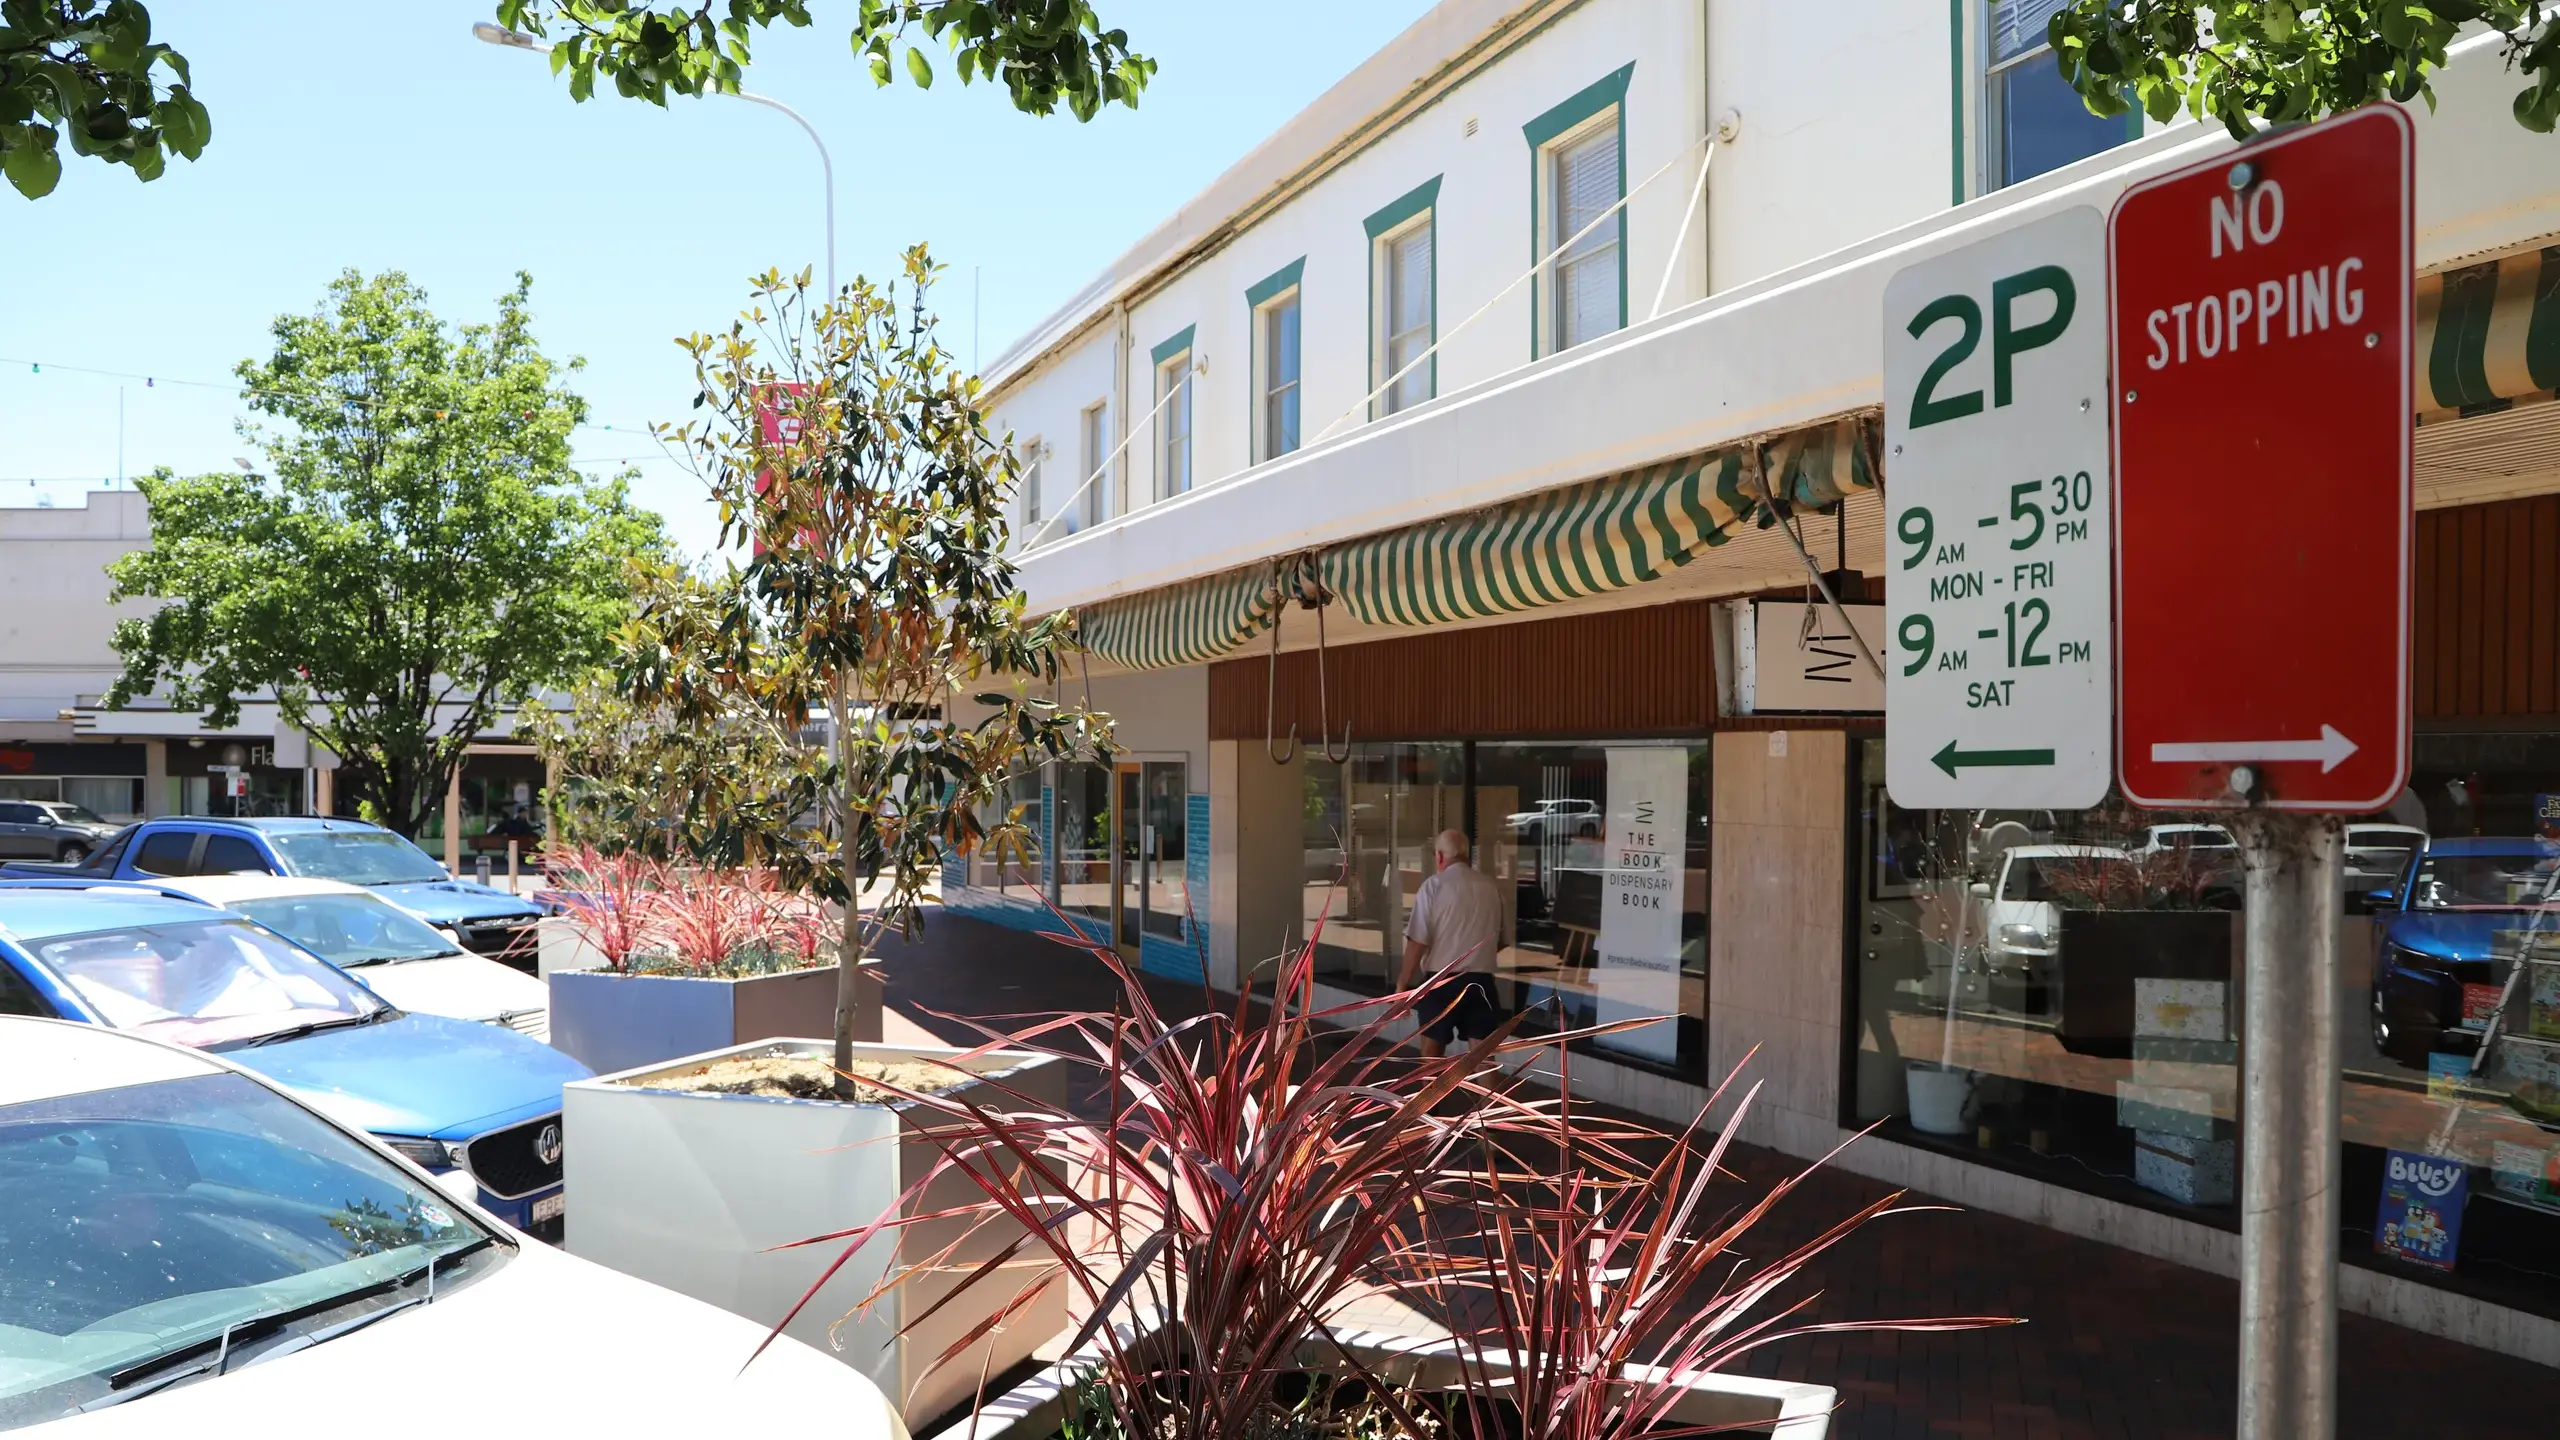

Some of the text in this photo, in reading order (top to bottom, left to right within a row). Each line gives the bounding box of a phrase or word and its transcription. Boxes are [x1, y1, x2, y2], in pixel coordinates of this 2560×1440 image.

[2211, 180, 2285, 258] NO
[2146, 257, 2365, 371] STOPPING
[1906, 264, 2077, 430] 2P
[1930, 570, 1983, 602] MON
[2013, 560, 2054, 592] FRI
[1966, 680, 2015, 708] SAT
[1628, 832, 1655, 847] THE
[1623, 853, 1662, 869] BOOK
[1610, 873, 1673, 892] DISPENSARY
[1622, 893, 1661, 910] BOOK
[2389, 1156, 2462, 1196] BLUEY
